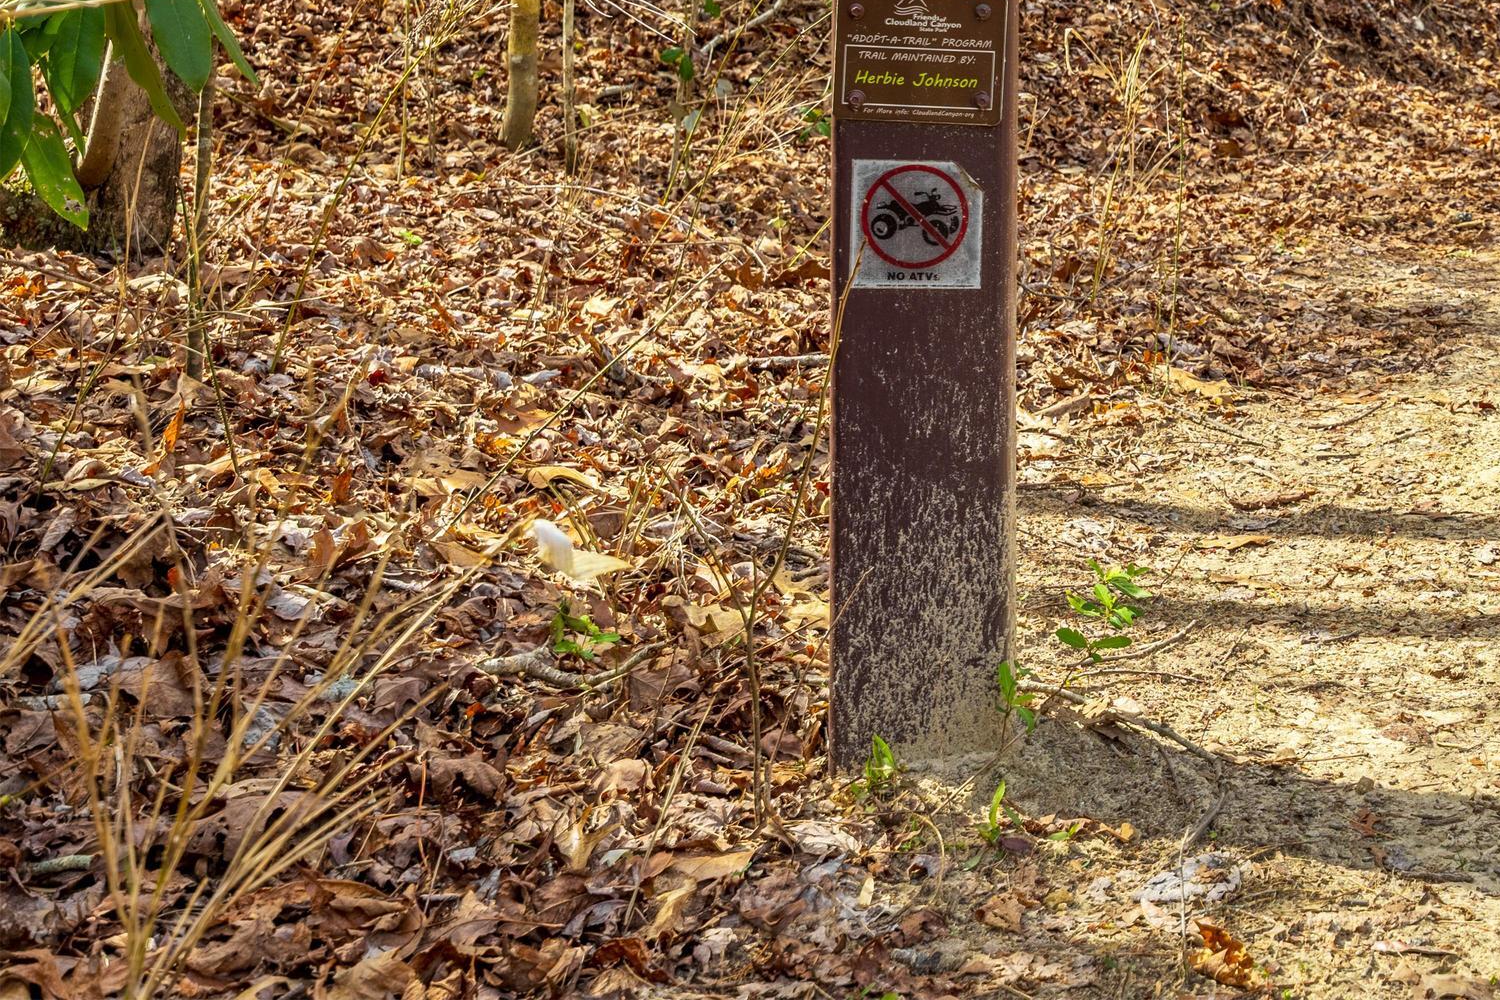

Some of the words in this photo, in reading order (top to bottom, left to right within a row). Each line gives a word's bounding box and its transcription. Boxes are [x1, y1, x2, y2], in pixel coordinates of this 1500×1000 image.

[913, 13, 940, 21] Friends
[885, 18, 928, 27] Cloudland
[930, 21, 962, 30] Canyon
[847, 34, 938, 46] "ADOPT-A-TRAIL"
[941, 37, 993, 49] PROGRAM
[858, 50, 887, 60] TRAIL
[891, 52, 956, 64] MAINTAINED
[960, 55, 977, 65] BY:
[854, 70, 905, 86] Herbie
[912, 73, 978, 89] Johnson
[876, 107, 893, 115] More
[887, 271, 906, 281] NO
